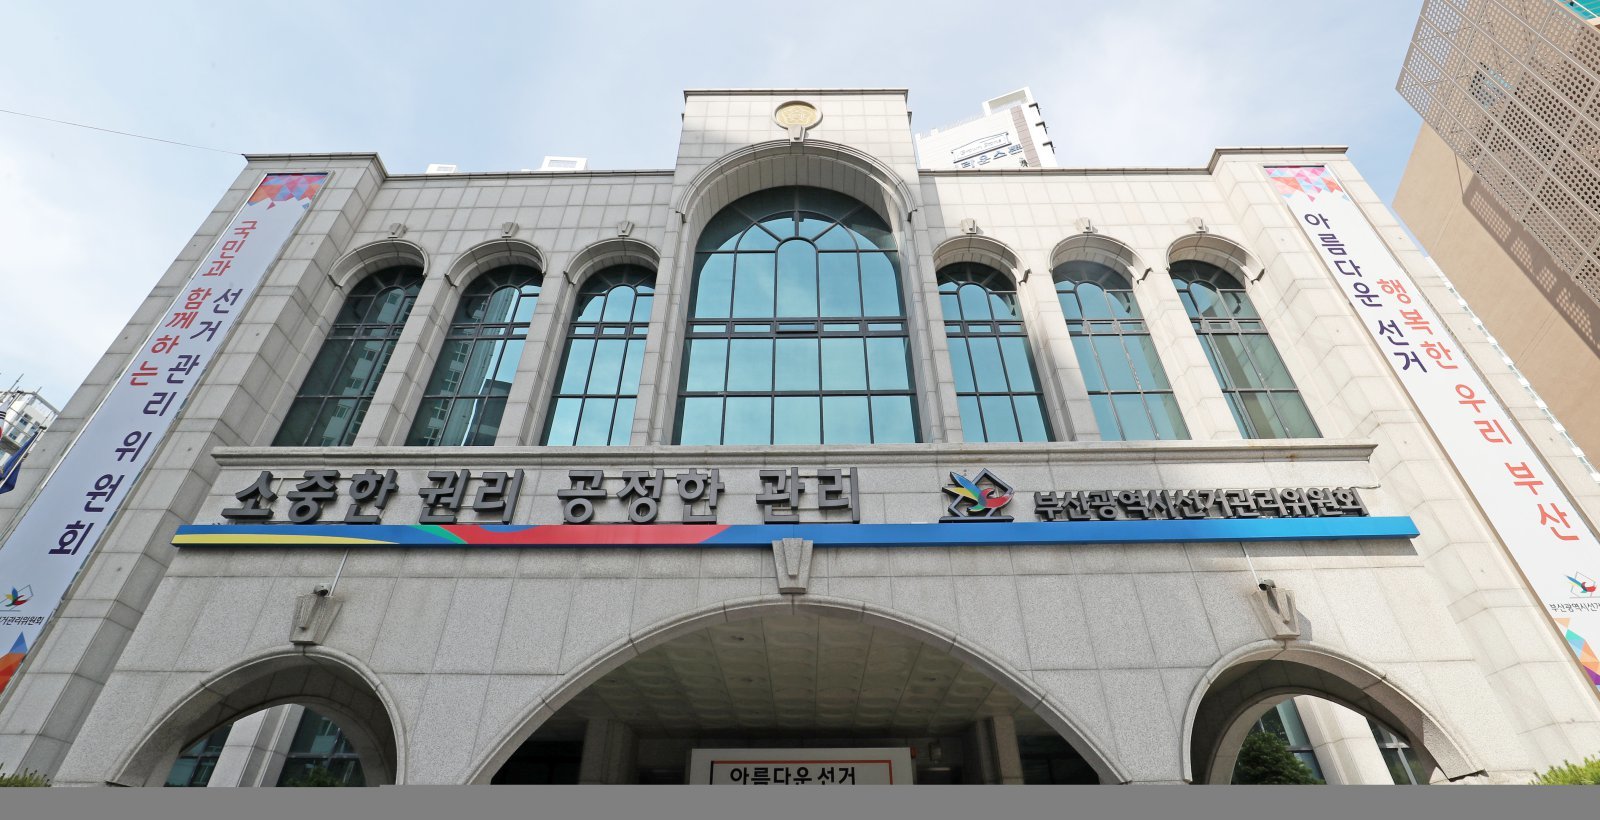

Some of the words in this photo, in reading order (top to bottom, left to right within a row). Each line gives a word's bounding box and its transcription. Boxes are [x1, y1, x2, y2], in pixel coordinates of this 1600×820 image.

[202, 221, 257, 276] 국민과
[1304, 213, 1383, 307] 아름다운
[1378, 320, 1428, 373] 선거
[130, 288, 212, 386] 함께하는
[48, 289, 243, 556] 선거관리위원회
[1376, 278, 1459, 370] 행복한
[1455, 384, 1513, 445] 우리
[1504, 462, 1580, 541] 부산
[221, 469, 399, 525] 소중한
[418, 469, 524, 525] 권리
[557, 467, 725, 525] 공정한
[756, 467, 860, 524] 관리
[1034, 489, 1369, 521] 부산광역시선거관리위원회
[0, 616, 45, 626] 거관리위원회
[730, 766, 813, 785] 아름다운
[817, 766, 856, 785] 선거
